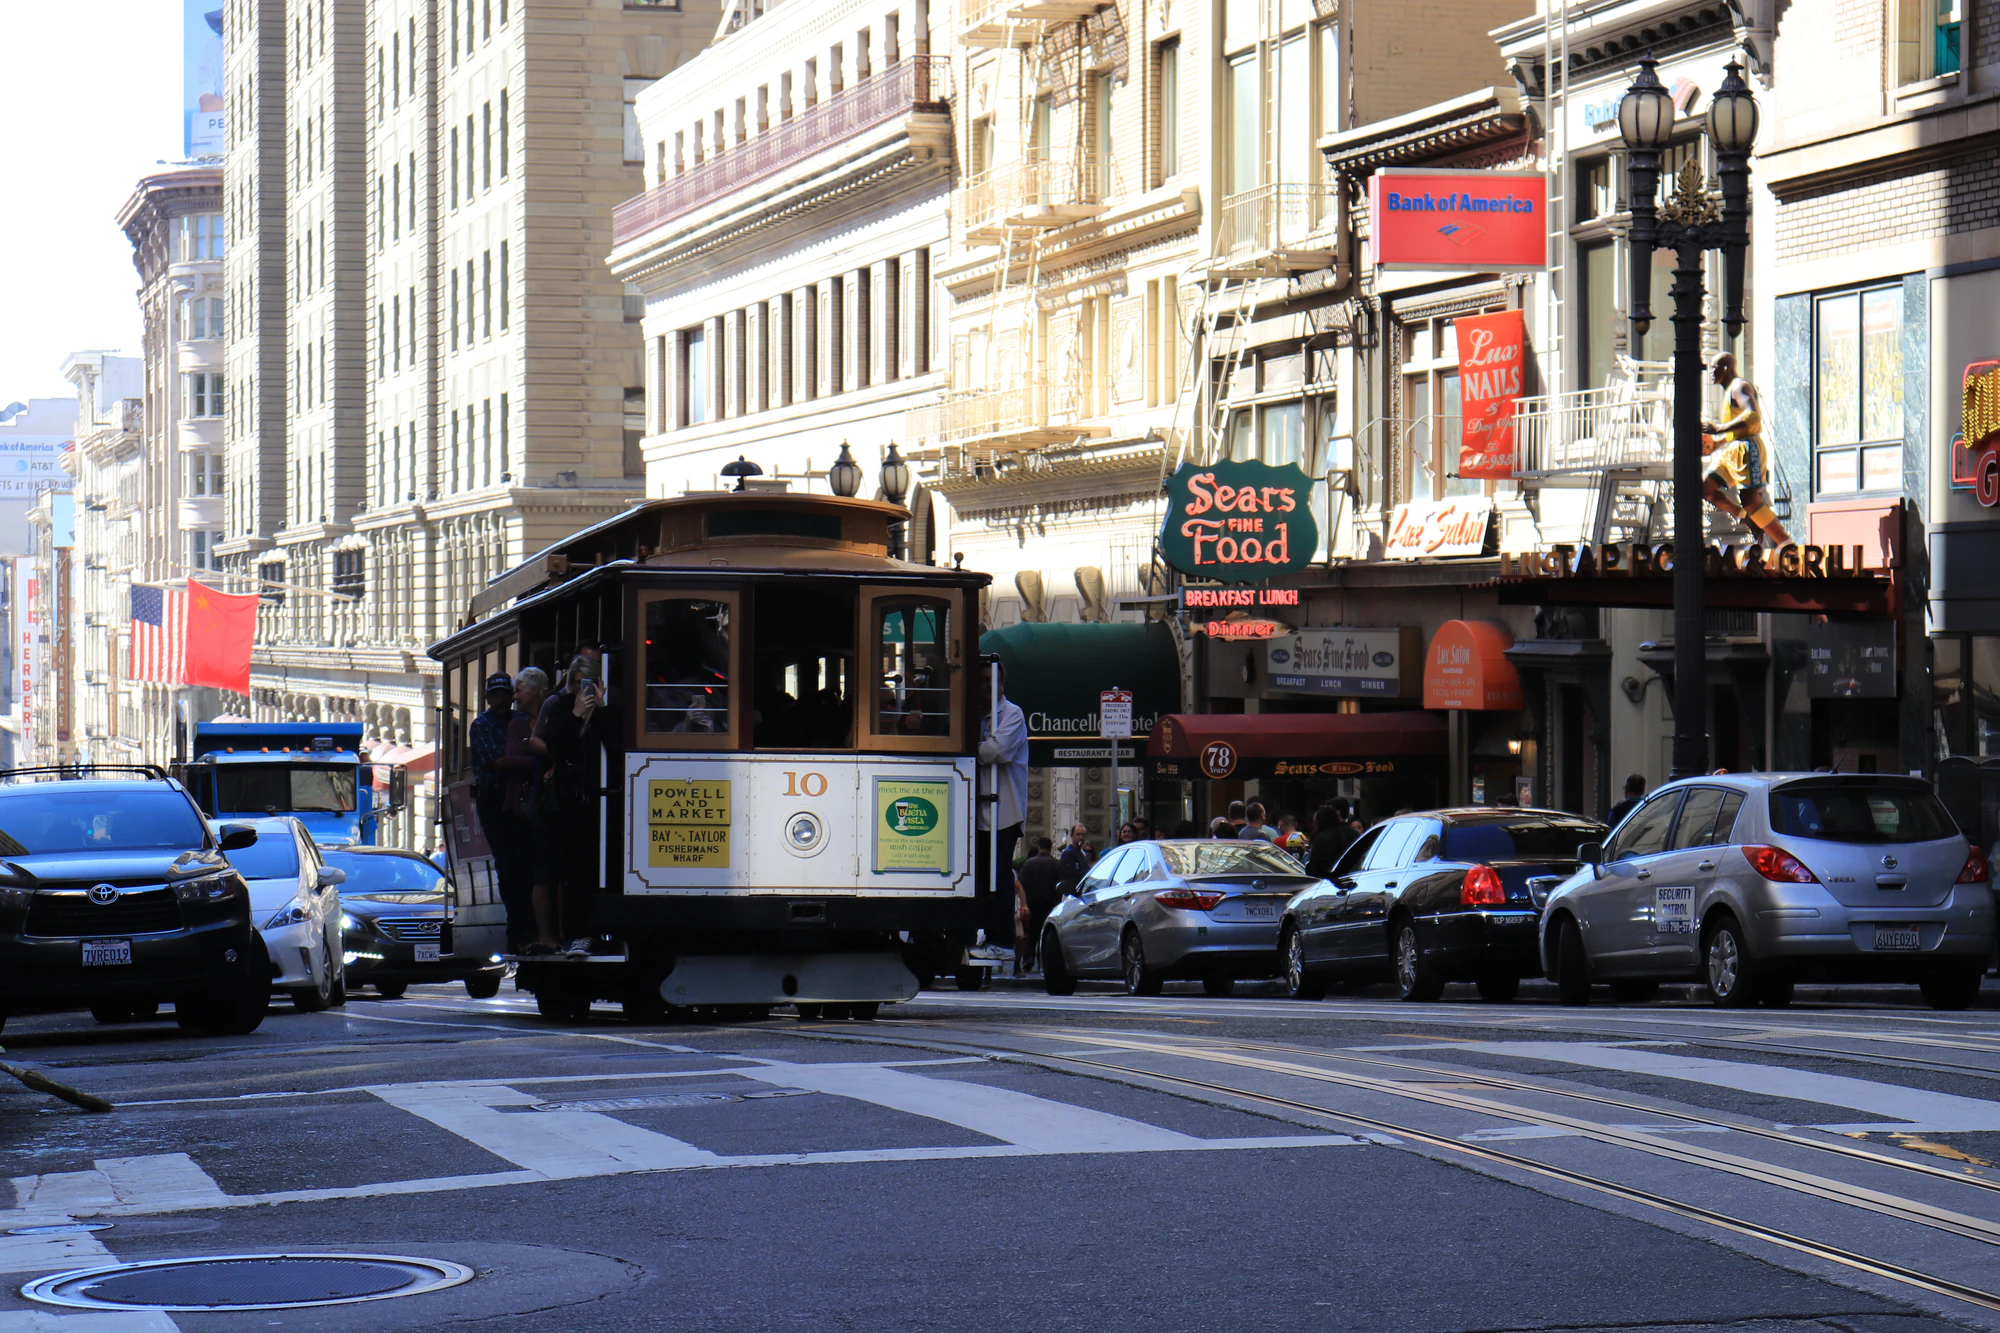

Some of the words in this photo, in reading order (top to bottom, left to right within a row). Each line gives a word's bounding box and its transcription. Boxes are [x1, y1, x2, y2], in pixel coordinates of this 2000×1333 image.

[1388, 192, 1437, 211] Bank
[1438, 192, 1458, 211] of
[1459, 193, 1533, 213] America
[1464, 329, 1519, 367] Lux
[1464, 366, 1520, 402] NAILS
[1467, 418, 1494, 440] Day
[20, 443, 54, 451] America
[31, 462, 54, 470] AT&T
[1976, 450, 2000, 508] G
[1185, 472, 1296, 515] Sears
[1228, 518, 1264, 533] FINE
[1424, 505, 1484, 553] Salon
[1181, 518, 1290, 565] Food
[1553, 544, 1621, 578] TAP
[1627, 543, 1735, 578] ROM
[1743, 543, 1766, 578] &
[1777, 543, 1875, 579] GRILL
[1185, 590, 1256, 606] BREAKFAST
[1260, 589, 1299, 605] LUNCH
[1208, 620, 1274, 636] Dinner
[1293, 636, 1322, 673] Sears
[1322, 637, 1345, 672] Fine
[1345, 638, 1369, 672] Food
[1438, 645, 1448, 664] Lux
[1451, 644, 1470, 664] Salon
[23, 632, 31, 740] HERBERT
[1276, 677, 1306, 686] BREAKFAST
[1321, 680, 1341, 688] LUNCH
[1361, 681, 1385, 689] DINNER
[1029, 712, 1101, 731] Chancell
[1131, 712, 1158, 732] otel
[1208, 747, 1230, 768] 78
[1274, 761, 1317, 776] Sears
[1365, 761, 1394, 773] Food
[782, 771, 828, 797] 10
[654, 788, 725, 798] POWELL
[652, 809, 726, 818] MARKET
[652, 831, 670, 842] BAY
[674, 831, 686, 842] AND
[689, 831, 726, 842] TAYLOR
[659, 845, 719, 853] FISHERMANS
[673, 854, 704, 862] WHARF
[1659, 889, 1692, 900] SECURITY
[1245, 907, 1274, 916] 7NCX081
[1662, 904, 1688, 915] PATROL
[84, 949, 129, 962] 7VRE019
